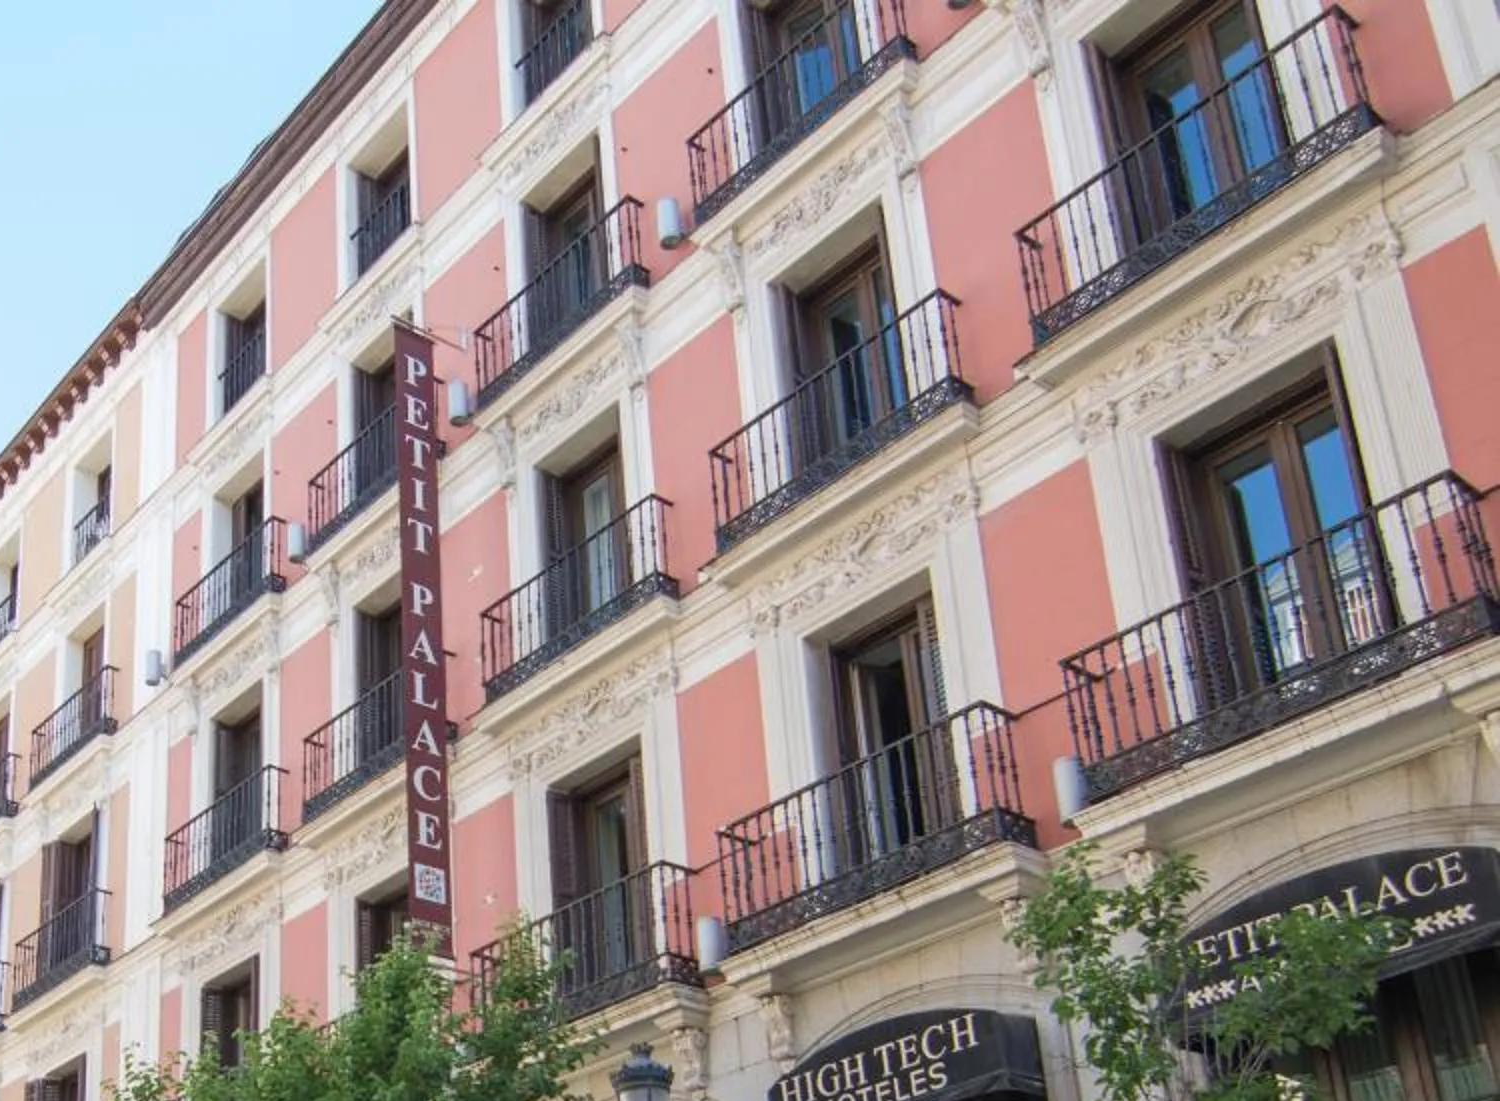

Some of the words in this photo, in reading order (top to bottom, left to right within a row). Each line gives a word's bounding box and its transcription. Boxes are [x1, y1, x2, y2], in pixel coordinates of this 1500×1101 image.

[402, 352, 434, 553] PETIT
[409, 583, 443, 851] PALACE
[1193, 912, 1283, 969] ETIT
[873, 1013, 980, 1077] TECH
